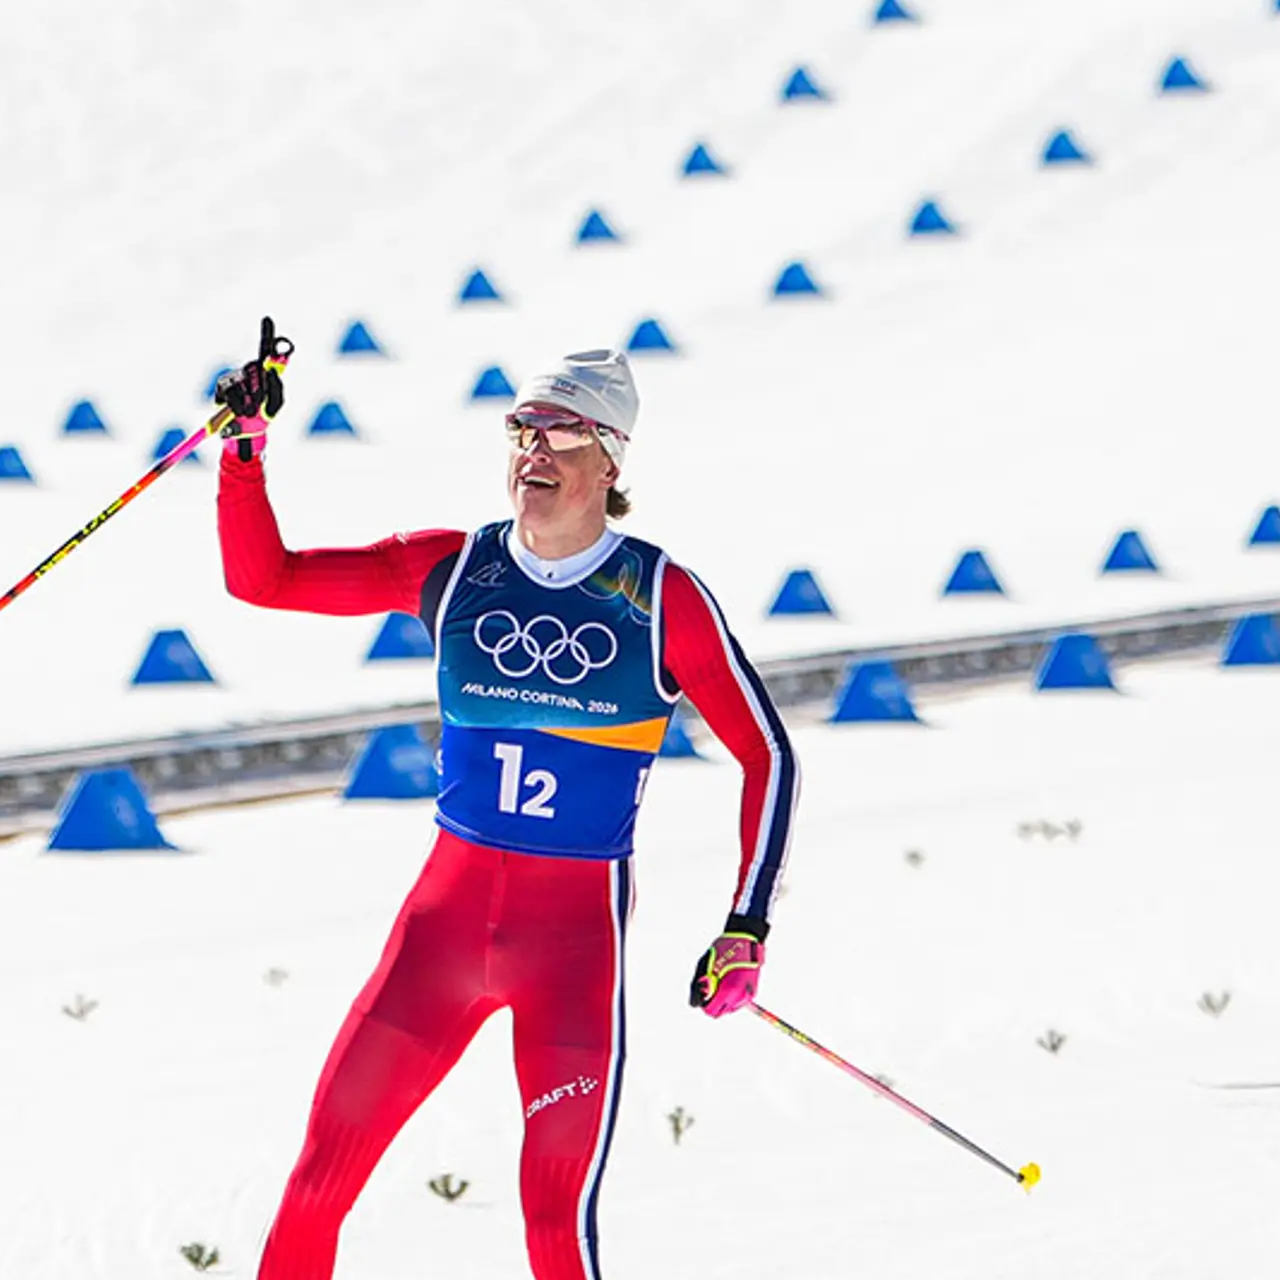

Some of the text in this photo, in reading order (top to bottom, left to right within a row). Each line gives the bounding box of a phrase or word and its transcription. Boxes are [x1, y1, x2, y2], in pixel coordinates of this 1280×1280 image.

[461, 682, 619, 715] MILANO CORTINA 2026
